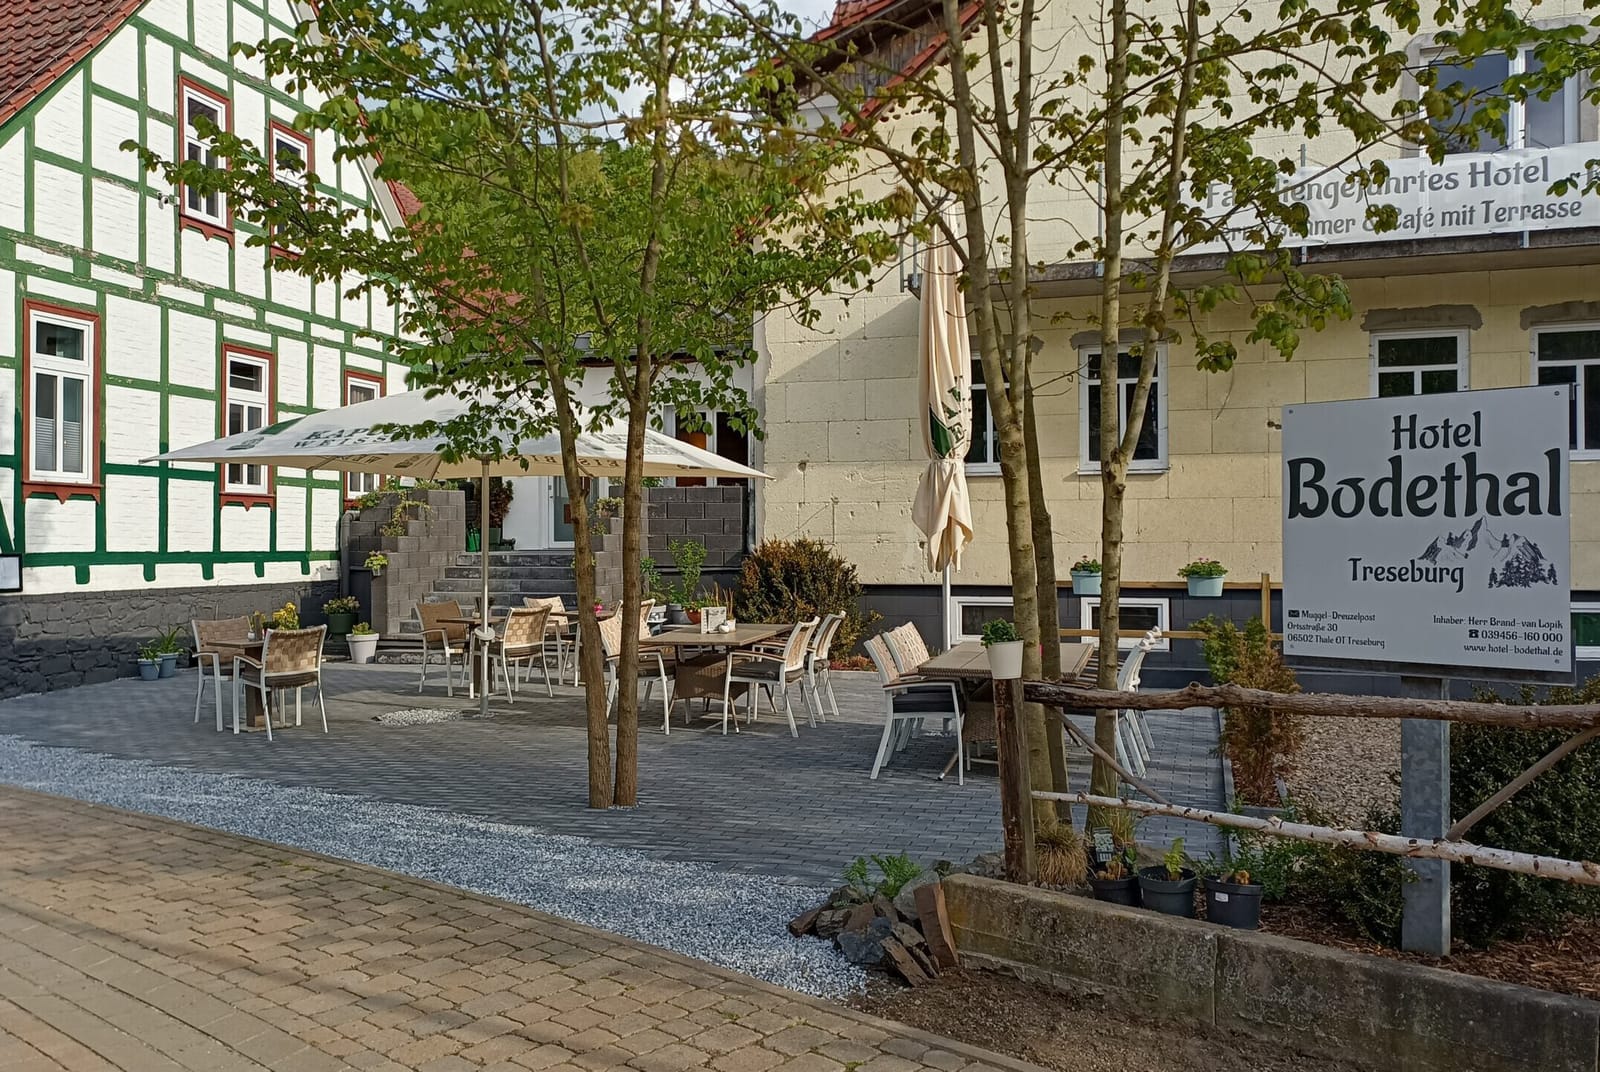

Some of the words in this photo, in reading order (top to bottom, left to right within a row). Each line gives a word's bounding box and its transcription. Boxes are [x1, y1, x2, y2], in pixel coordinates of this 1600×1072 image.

[1207, 169, 1459, 209] Faliengefhrtes
[1468, 156, 1548, 188] Hotel
[1273, 216, 1356, 238] Zmer
[1391, 205, 1435, 234] afé
[1441, 204, 1475, 227] mit
[1480, 199, 1582, 225] Terrasse
[1391, 411, 1482, 450] Hotel
[1287, 448, 1562, 519] Bodethal
[1348, 557, 1464, 593] Treseburg
[1287, 621, 1326, 632] Ortsstraße
[1327, 623, 1338, 632] 30
[1433, 614, 1466, 625] Inhaber:
[1468, 616, 1488, 626] Herr
[1538, 619, 1563, 631] Lopik
[1287, 633, 1314, 643] 06502
[1315, 634, 1334, 645] Thale
[1335, 636, 1346, 645] OT
[1347, 636, 1385, 649] Treseburg
[1463, 643, 1563, 657] www.hotel-bodethal.de
[1542, 632, 1563, 642] 000
